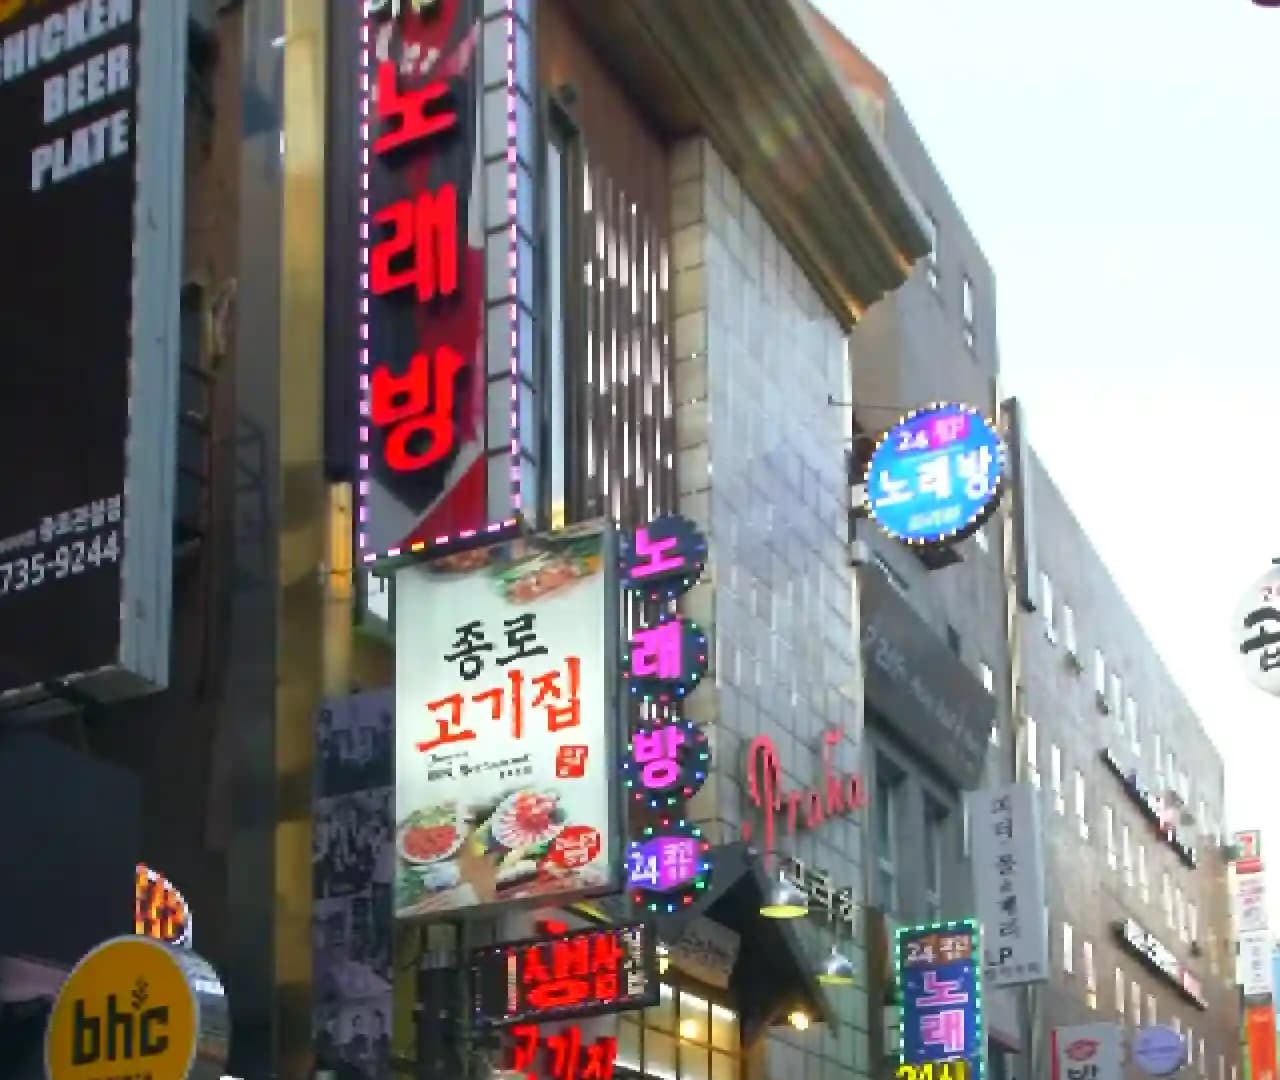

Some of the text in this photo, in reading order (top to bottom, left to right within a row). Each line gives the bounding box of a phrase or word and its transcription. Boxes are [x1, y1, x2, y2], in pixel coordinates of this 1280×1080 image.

[43, 43, 129, 124] BEER
[31, 108, 129, 191] PLATE
[369, 60, 464, 471] 노래방
[875, 445, 993, 507] 노래방
[444, 613, 549, 681] 종로
[630, 528, 686, 789] 노래방
[415, 655, 582, 752] 고기집
[72, 993, 170, 1066] bhc
